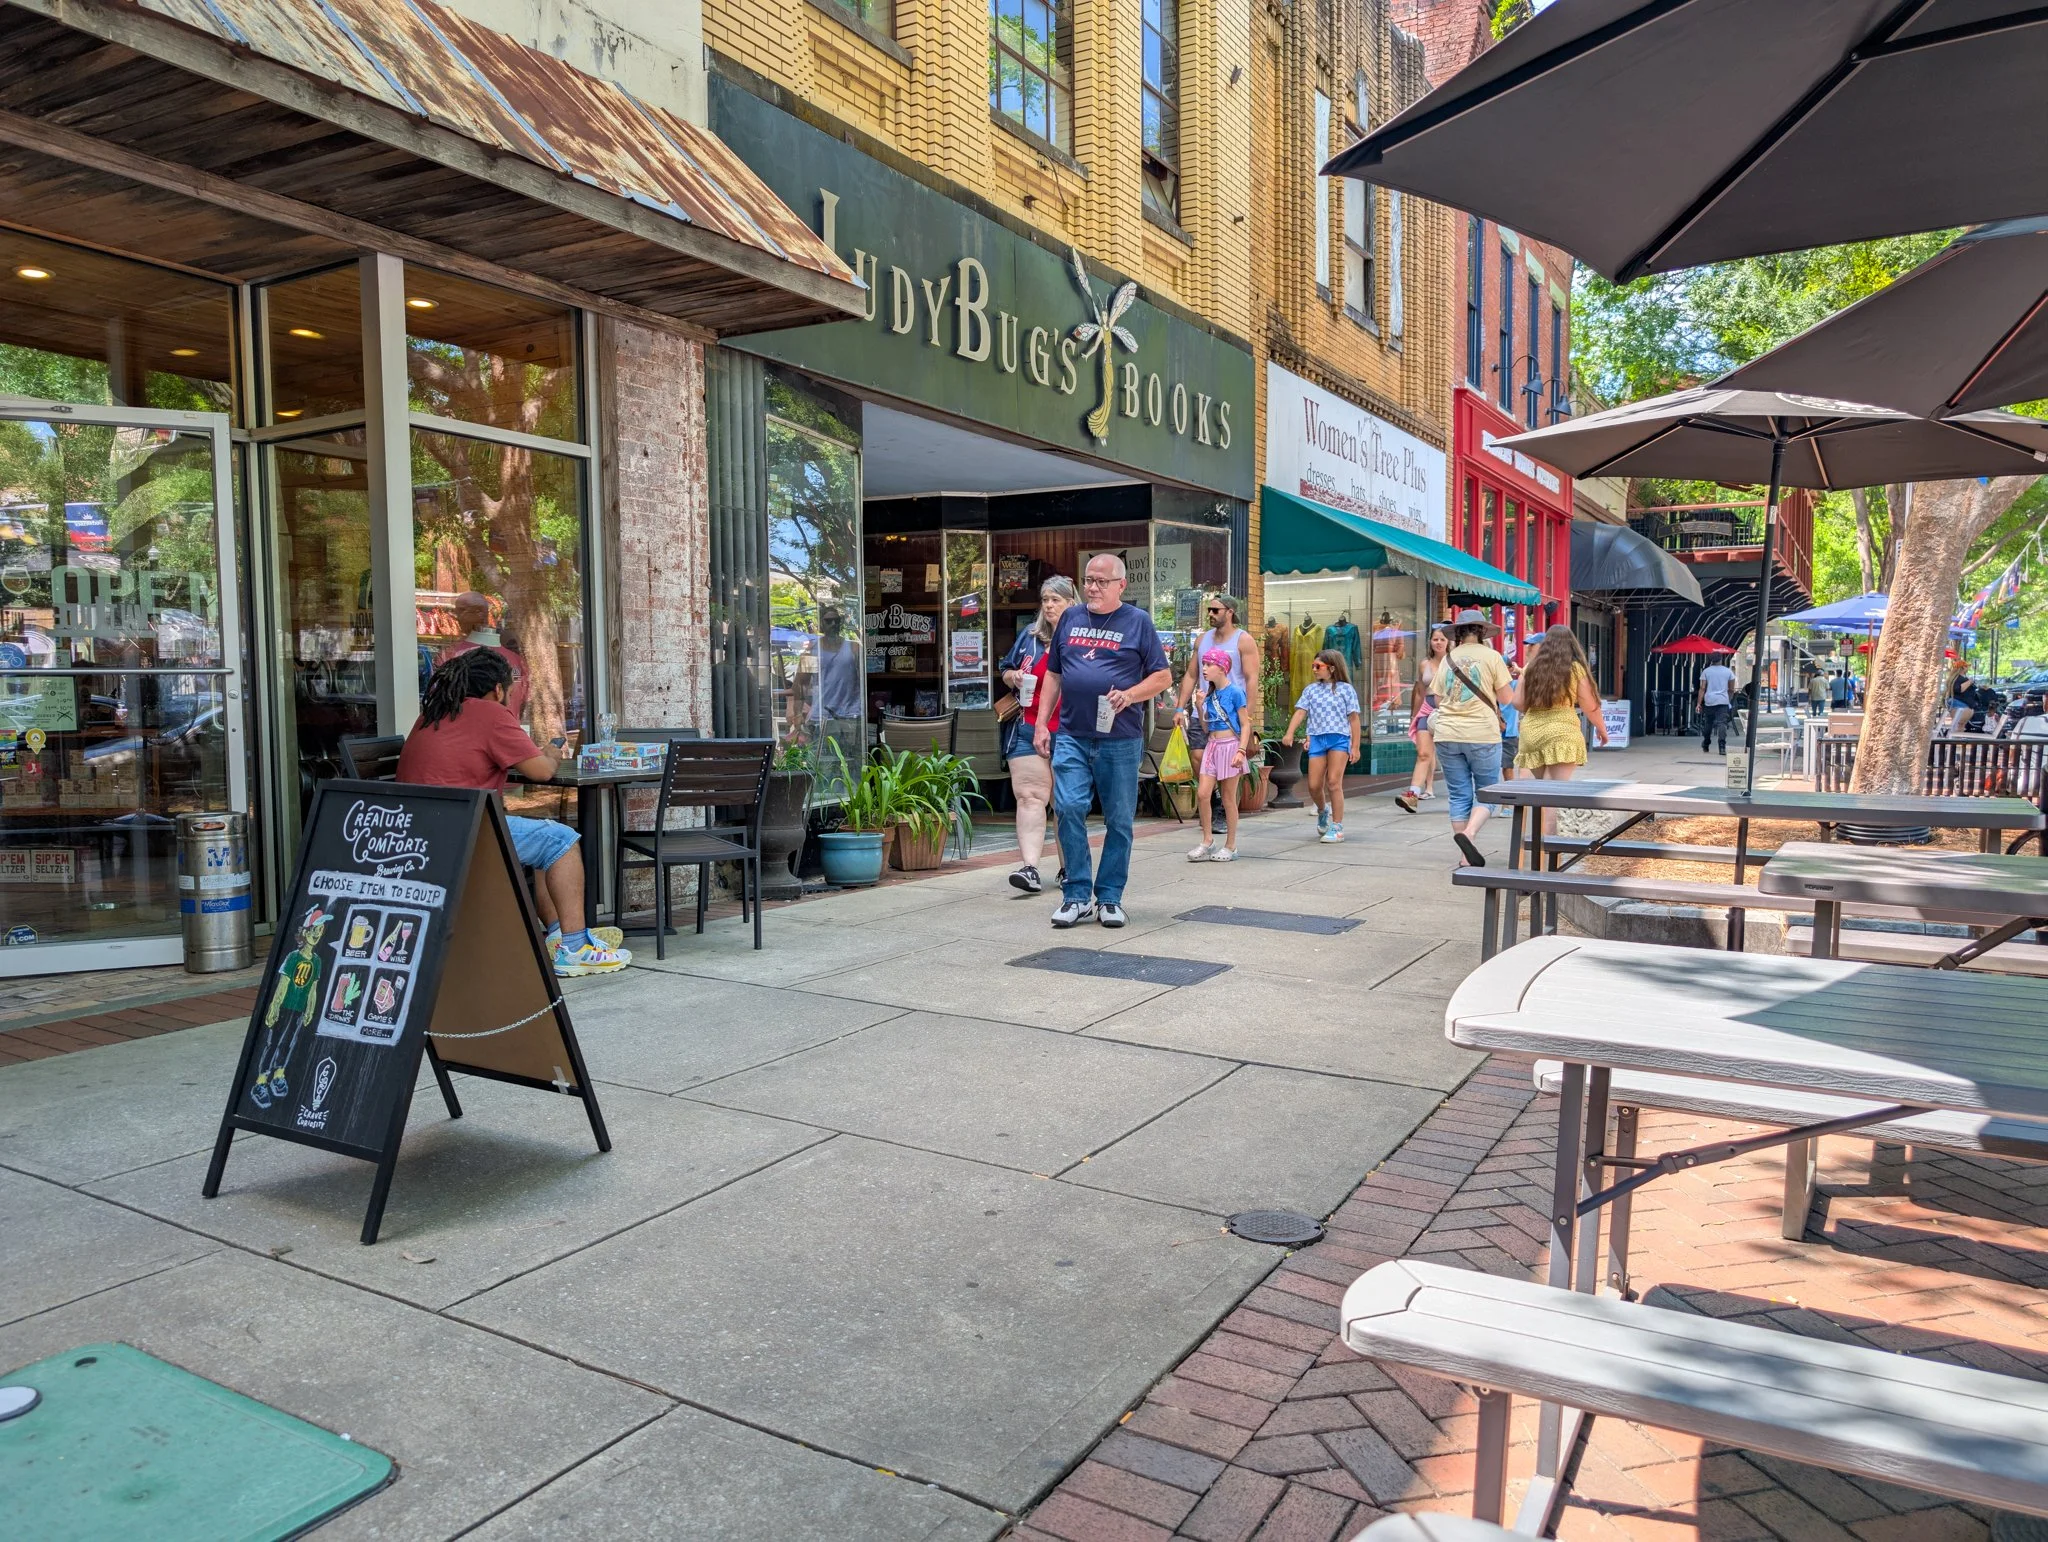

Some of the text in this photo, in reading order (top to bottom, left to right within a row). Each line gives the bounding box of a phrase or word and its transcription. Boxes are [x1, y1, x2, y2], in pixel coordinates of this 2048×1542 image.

[1124, 362, 1232, 451] BOOKS
[1303, 396, 1368, 469] Women's
[1371, 430, 1400, 481] Tree
[1403, 446, 1427, 493] Plus
[51, 565, 218, 624] OPEN
[865, 609, 888, 629] UDY
[1070, 627, 1124, 643] BRAVES
[343, 800, 413, 841] CREATURE
[352, 827, 430, 870] COMFORTS
[36, 854, 69, 864] SIP'EM
[36, 865, 69, 873] SELTZER
[374, 863, 404, 879] Brewing
[313, 876, 440, 903] CHOOSE ITEM TO EQUIP
[345, 949, 366, 958] BEER
[390, 955, 406, 963] WINE
[328, 1013, 351, 1023] DRINKS
[342, 1009, 354, 1018] THC
[367, 1012, 393, 1024] GAMES
[303, 1109, 323, 1119] CRAVE
[297, 1117, 325, 1129] CURIOSITY
